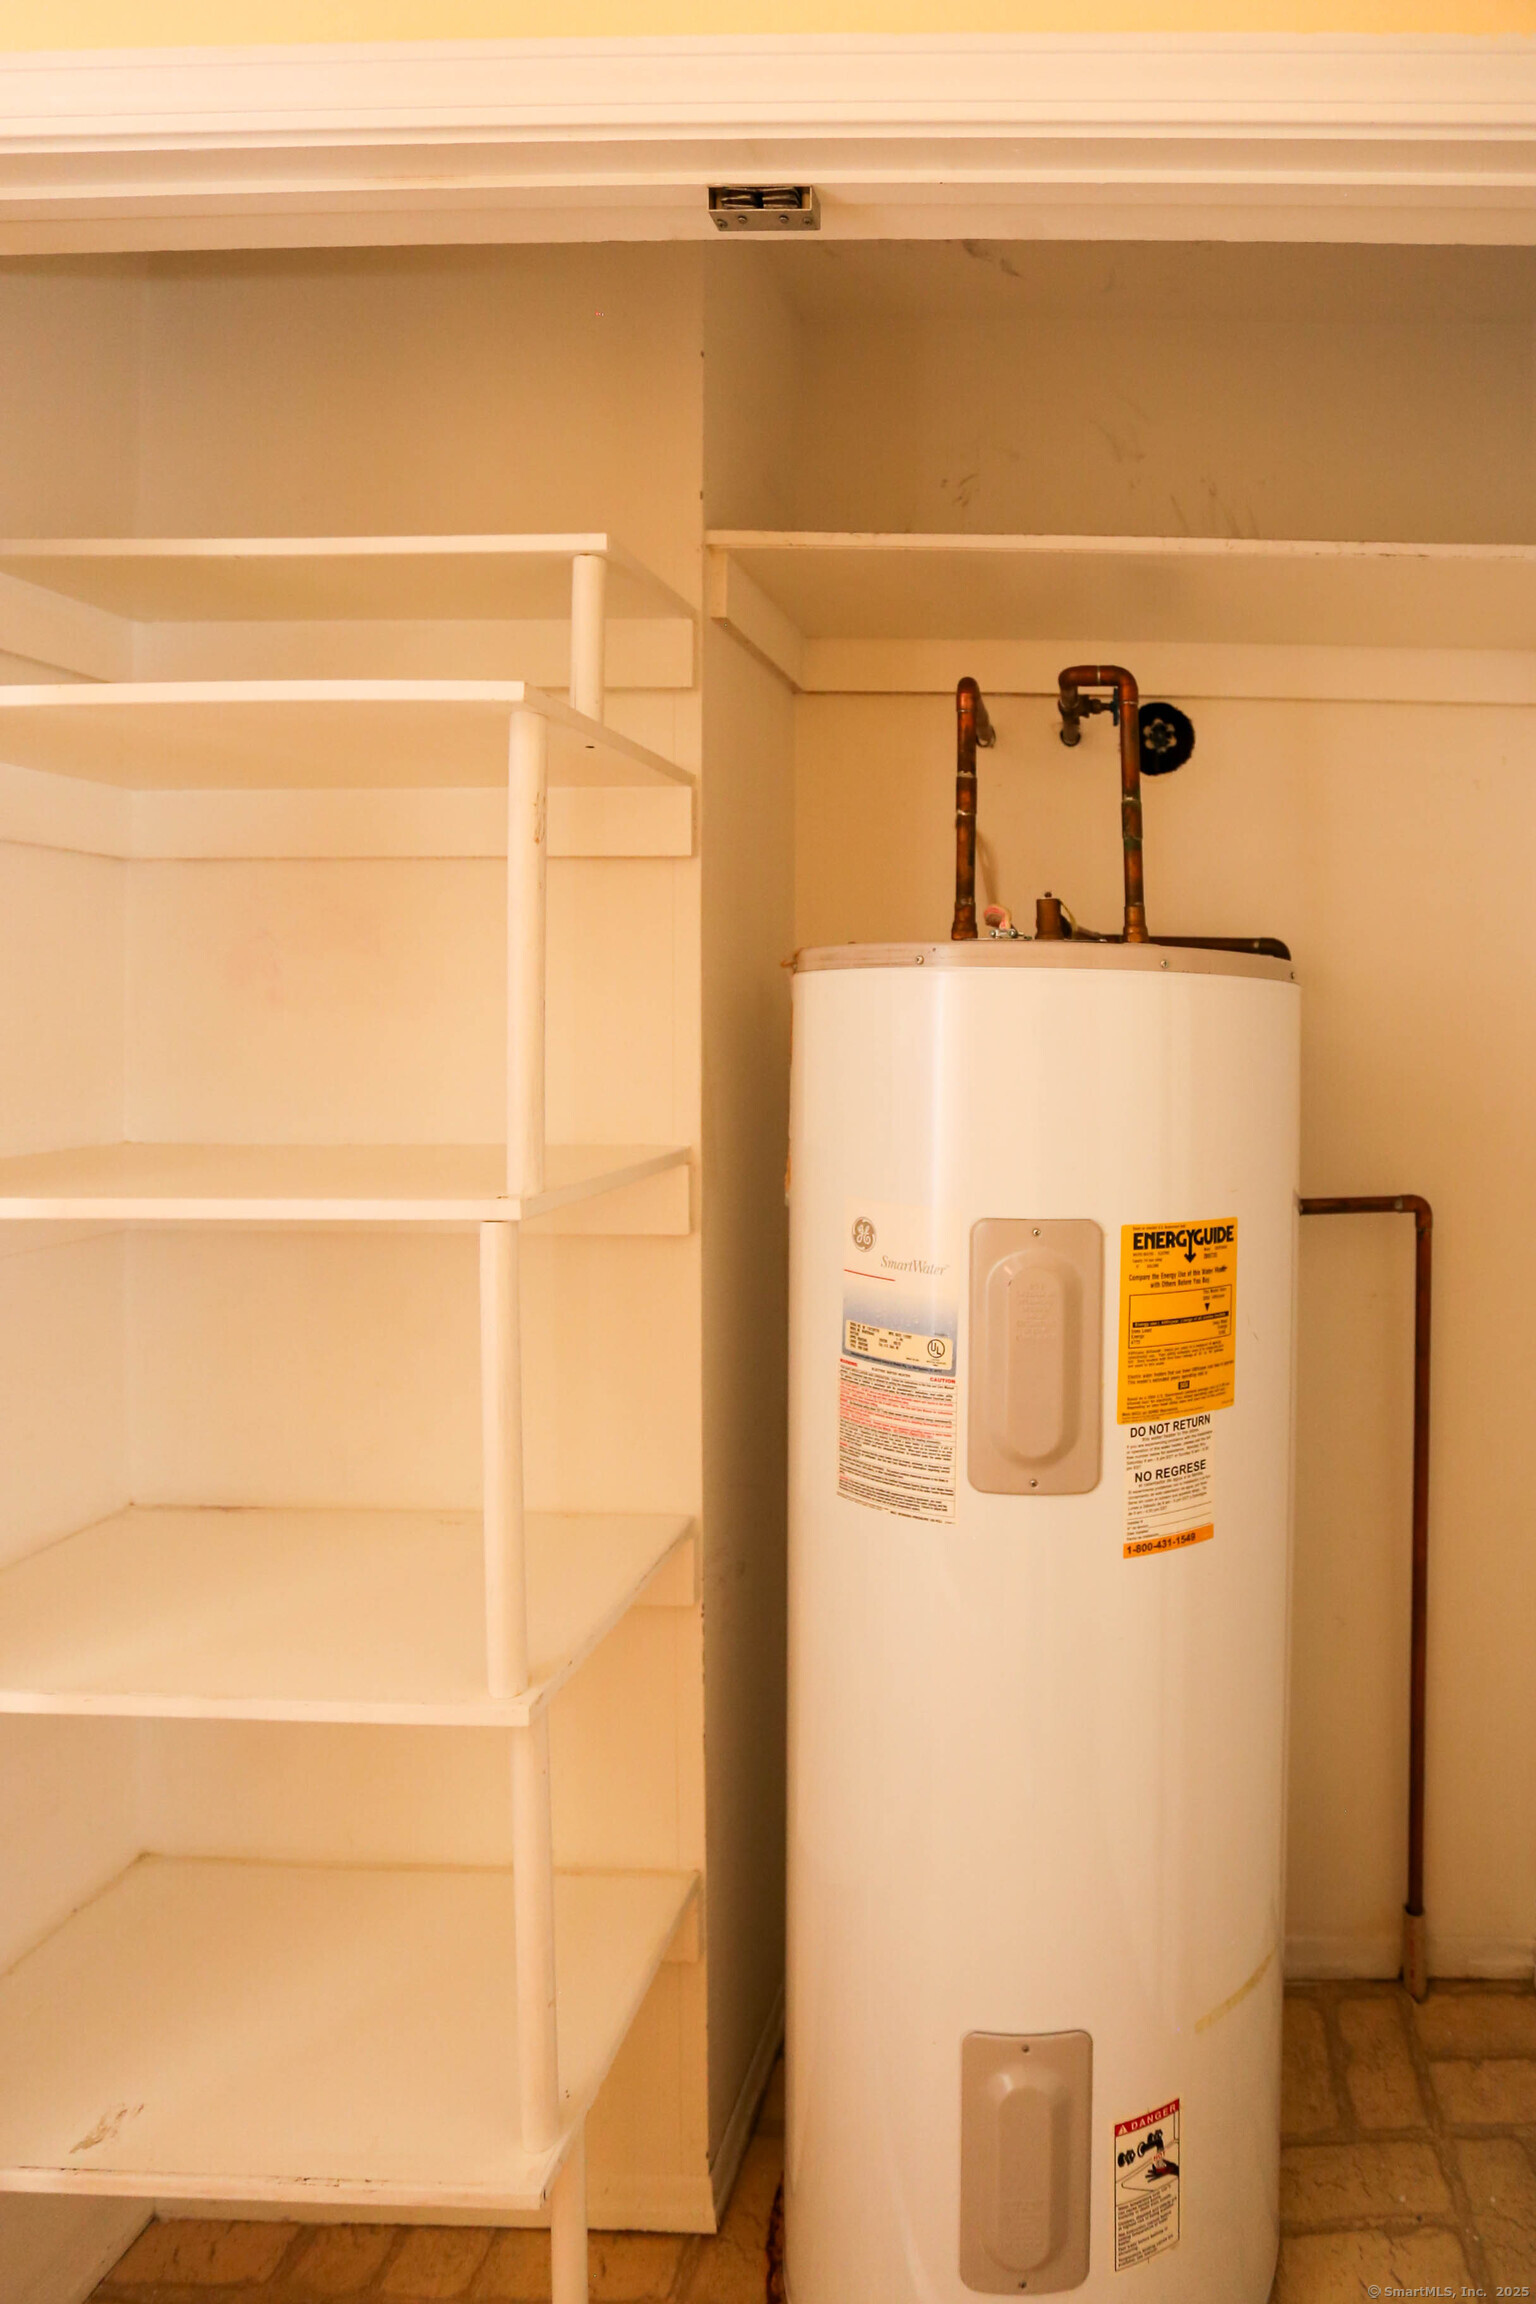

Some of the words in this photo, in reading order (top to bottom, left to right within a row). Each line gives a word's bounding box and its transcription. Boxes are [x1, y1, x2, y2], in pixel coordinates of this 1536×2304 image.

[1133, 1225, 1235, 1251] ENERGYGUIDE
[1161, 1271, 1177, 1281] Energy
[929, 1376, 956, 1384] CAUTION
[1130, 1426, 1146, 1438] DO
[1149, 1422, 1171, 1436] NOT
[1173, 1413, 1211, 1432] RETURN
[1134, 1471, 1152, 1483] NO
[1155, 1459, 1207, 1480] REGRESE
[1126, 1532, 1197, 1555] 1-800-431-1549
[1130, 2103, 1177, 2131] DANGER
